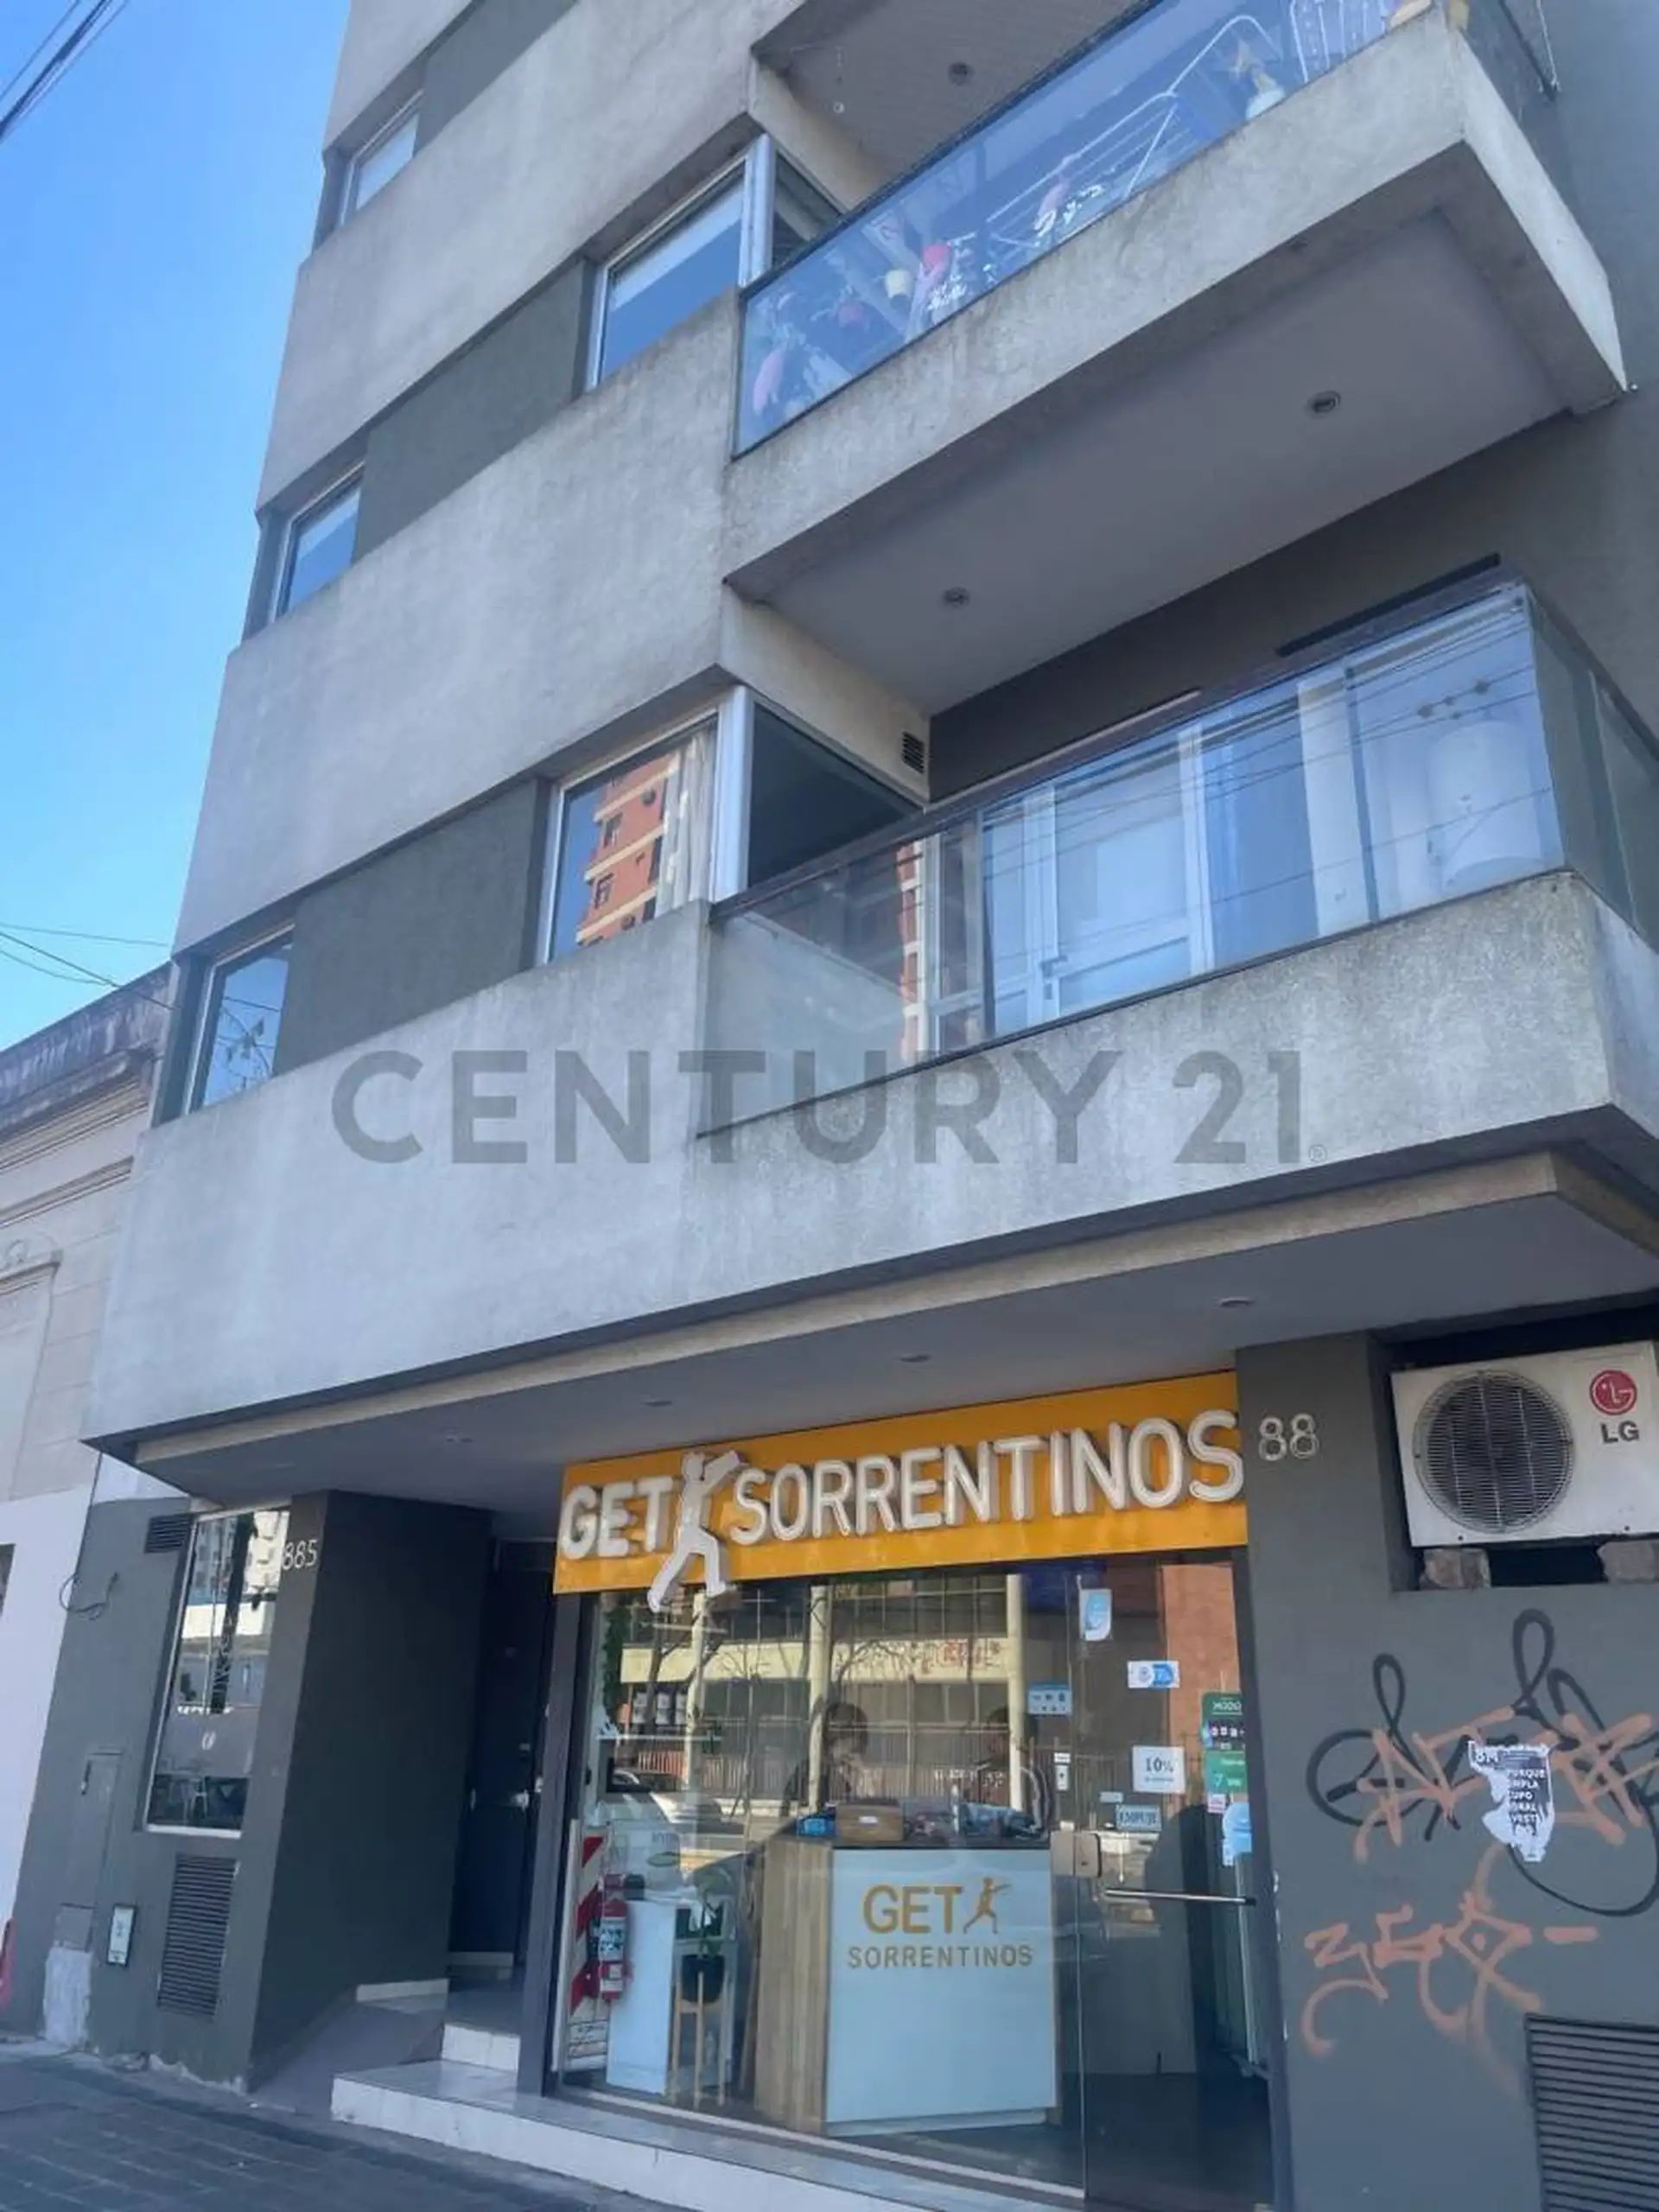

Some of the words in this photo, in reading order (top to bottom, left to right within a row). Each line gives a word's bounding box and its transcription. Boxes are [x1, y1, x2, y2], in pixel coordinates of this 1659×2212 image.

[1258, 1413, 1319, 1462] 88
[1600, 1420, 1640, 1444] LG
[560, 1474, 673, 1560] GET
[730, 1408, 1245, 1547] SORRENTINOS
[282, 1539, 319, 1571] 885
[862, 1884, 963, 1935] GET
[848, 1944, 1034, 1970] SORRENTINOS
